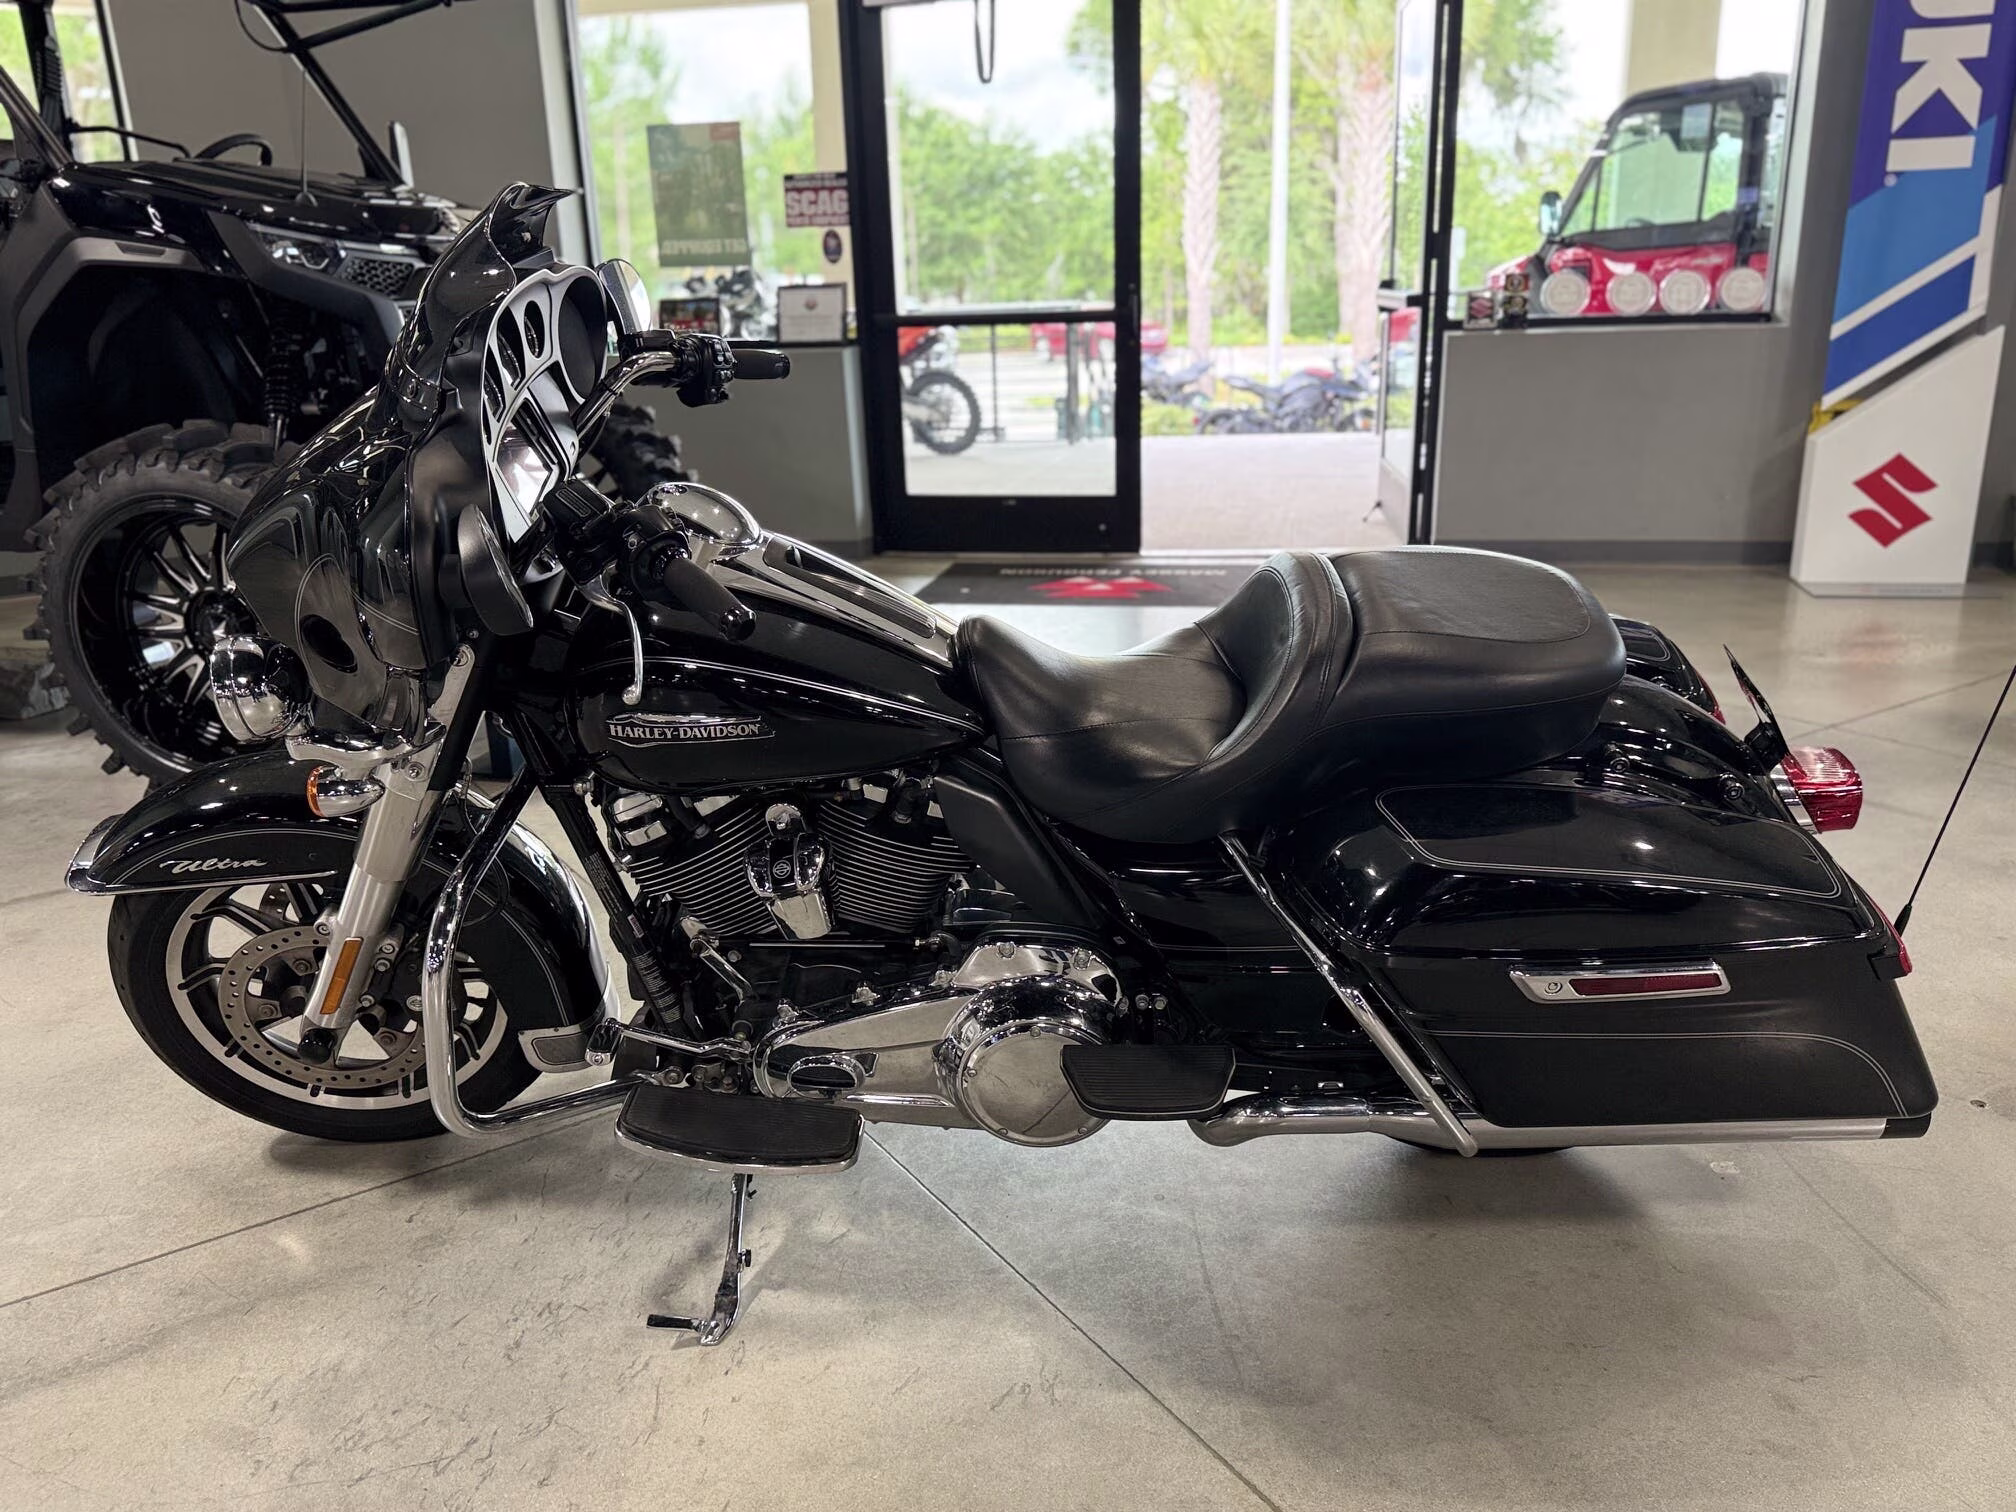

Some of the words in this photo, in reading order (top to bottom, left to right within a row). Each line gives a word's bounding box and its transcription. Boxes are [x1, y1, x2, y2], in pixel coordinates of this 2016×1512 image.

[1886, 0, 1995, 172] KI
[785, 189, 849, 215] SCAG
[608, 723, 761, 739] HARLEY-DAVIDSON
[159, 857, 268, 874] Ultra
